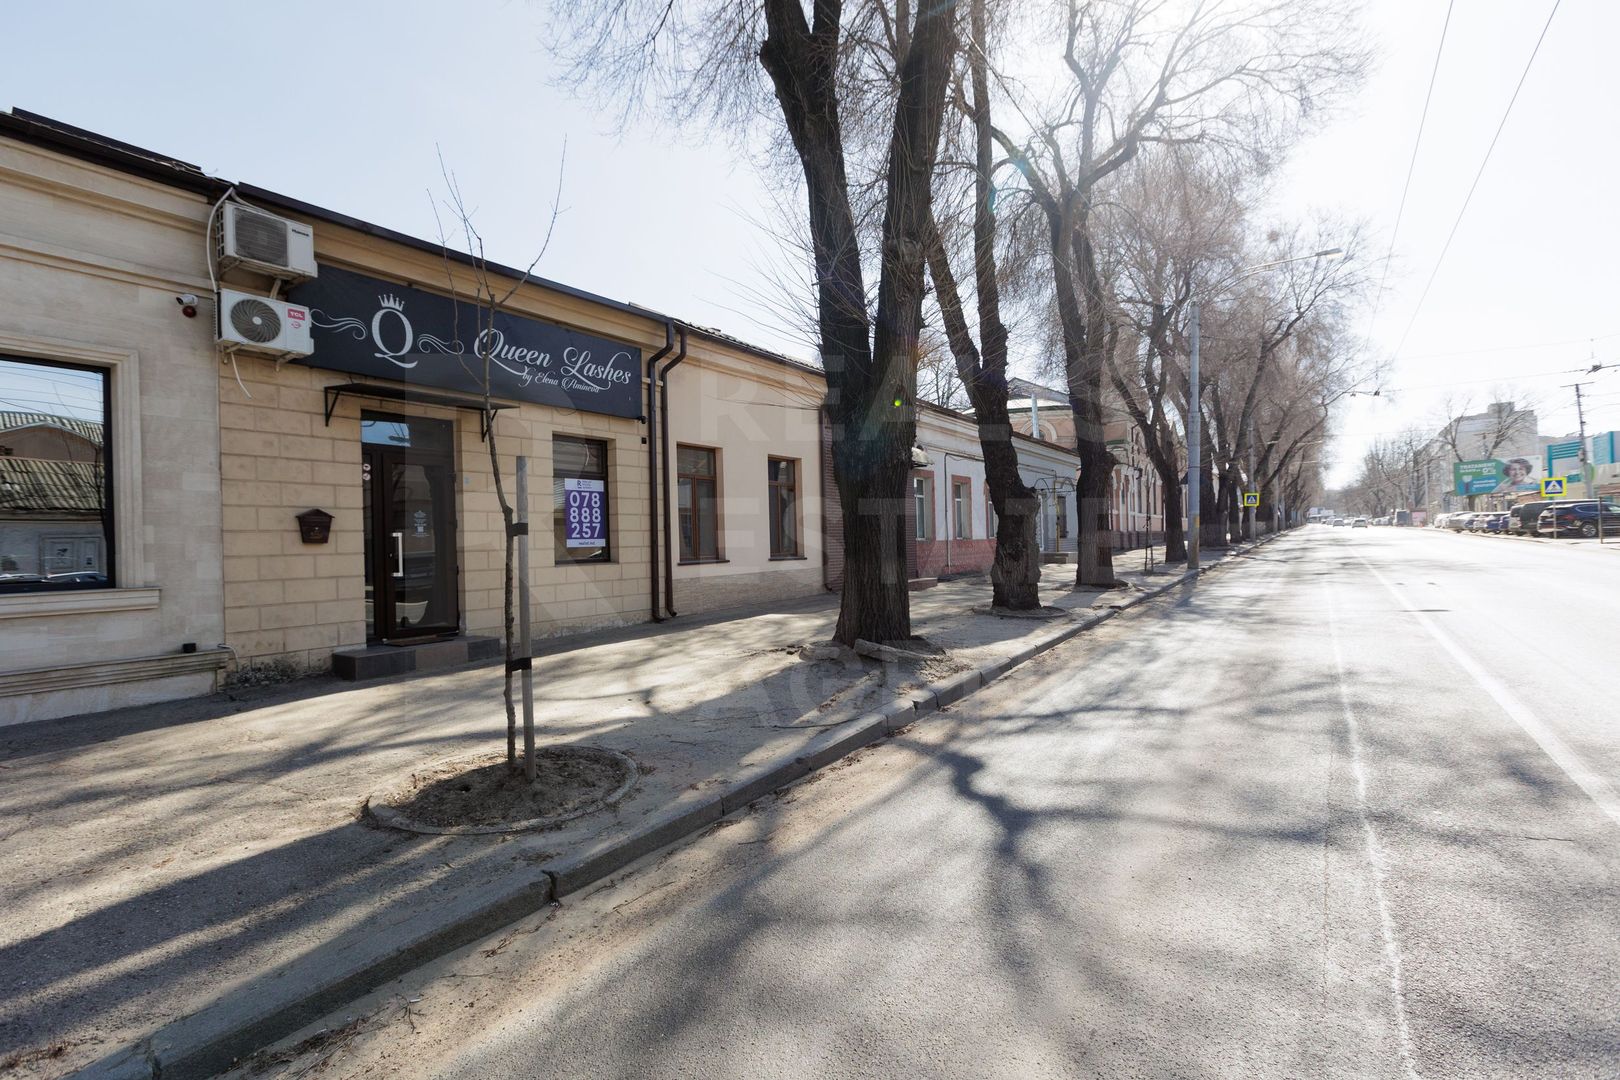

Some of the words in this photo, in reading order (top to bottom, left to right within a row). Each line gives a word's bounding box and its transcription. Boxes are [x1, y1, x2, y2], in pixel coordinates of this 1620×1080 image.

[473, 327, 552, 376] Queen
[560, 346, 632, 391] Lashes
[518, 366, 535, 388] by
[535, 370, 559, 386] Elena
[569, 491, 600, 508] 078
[569, 507, 601, 523] 888
[571, 522, 600, 538] 257
